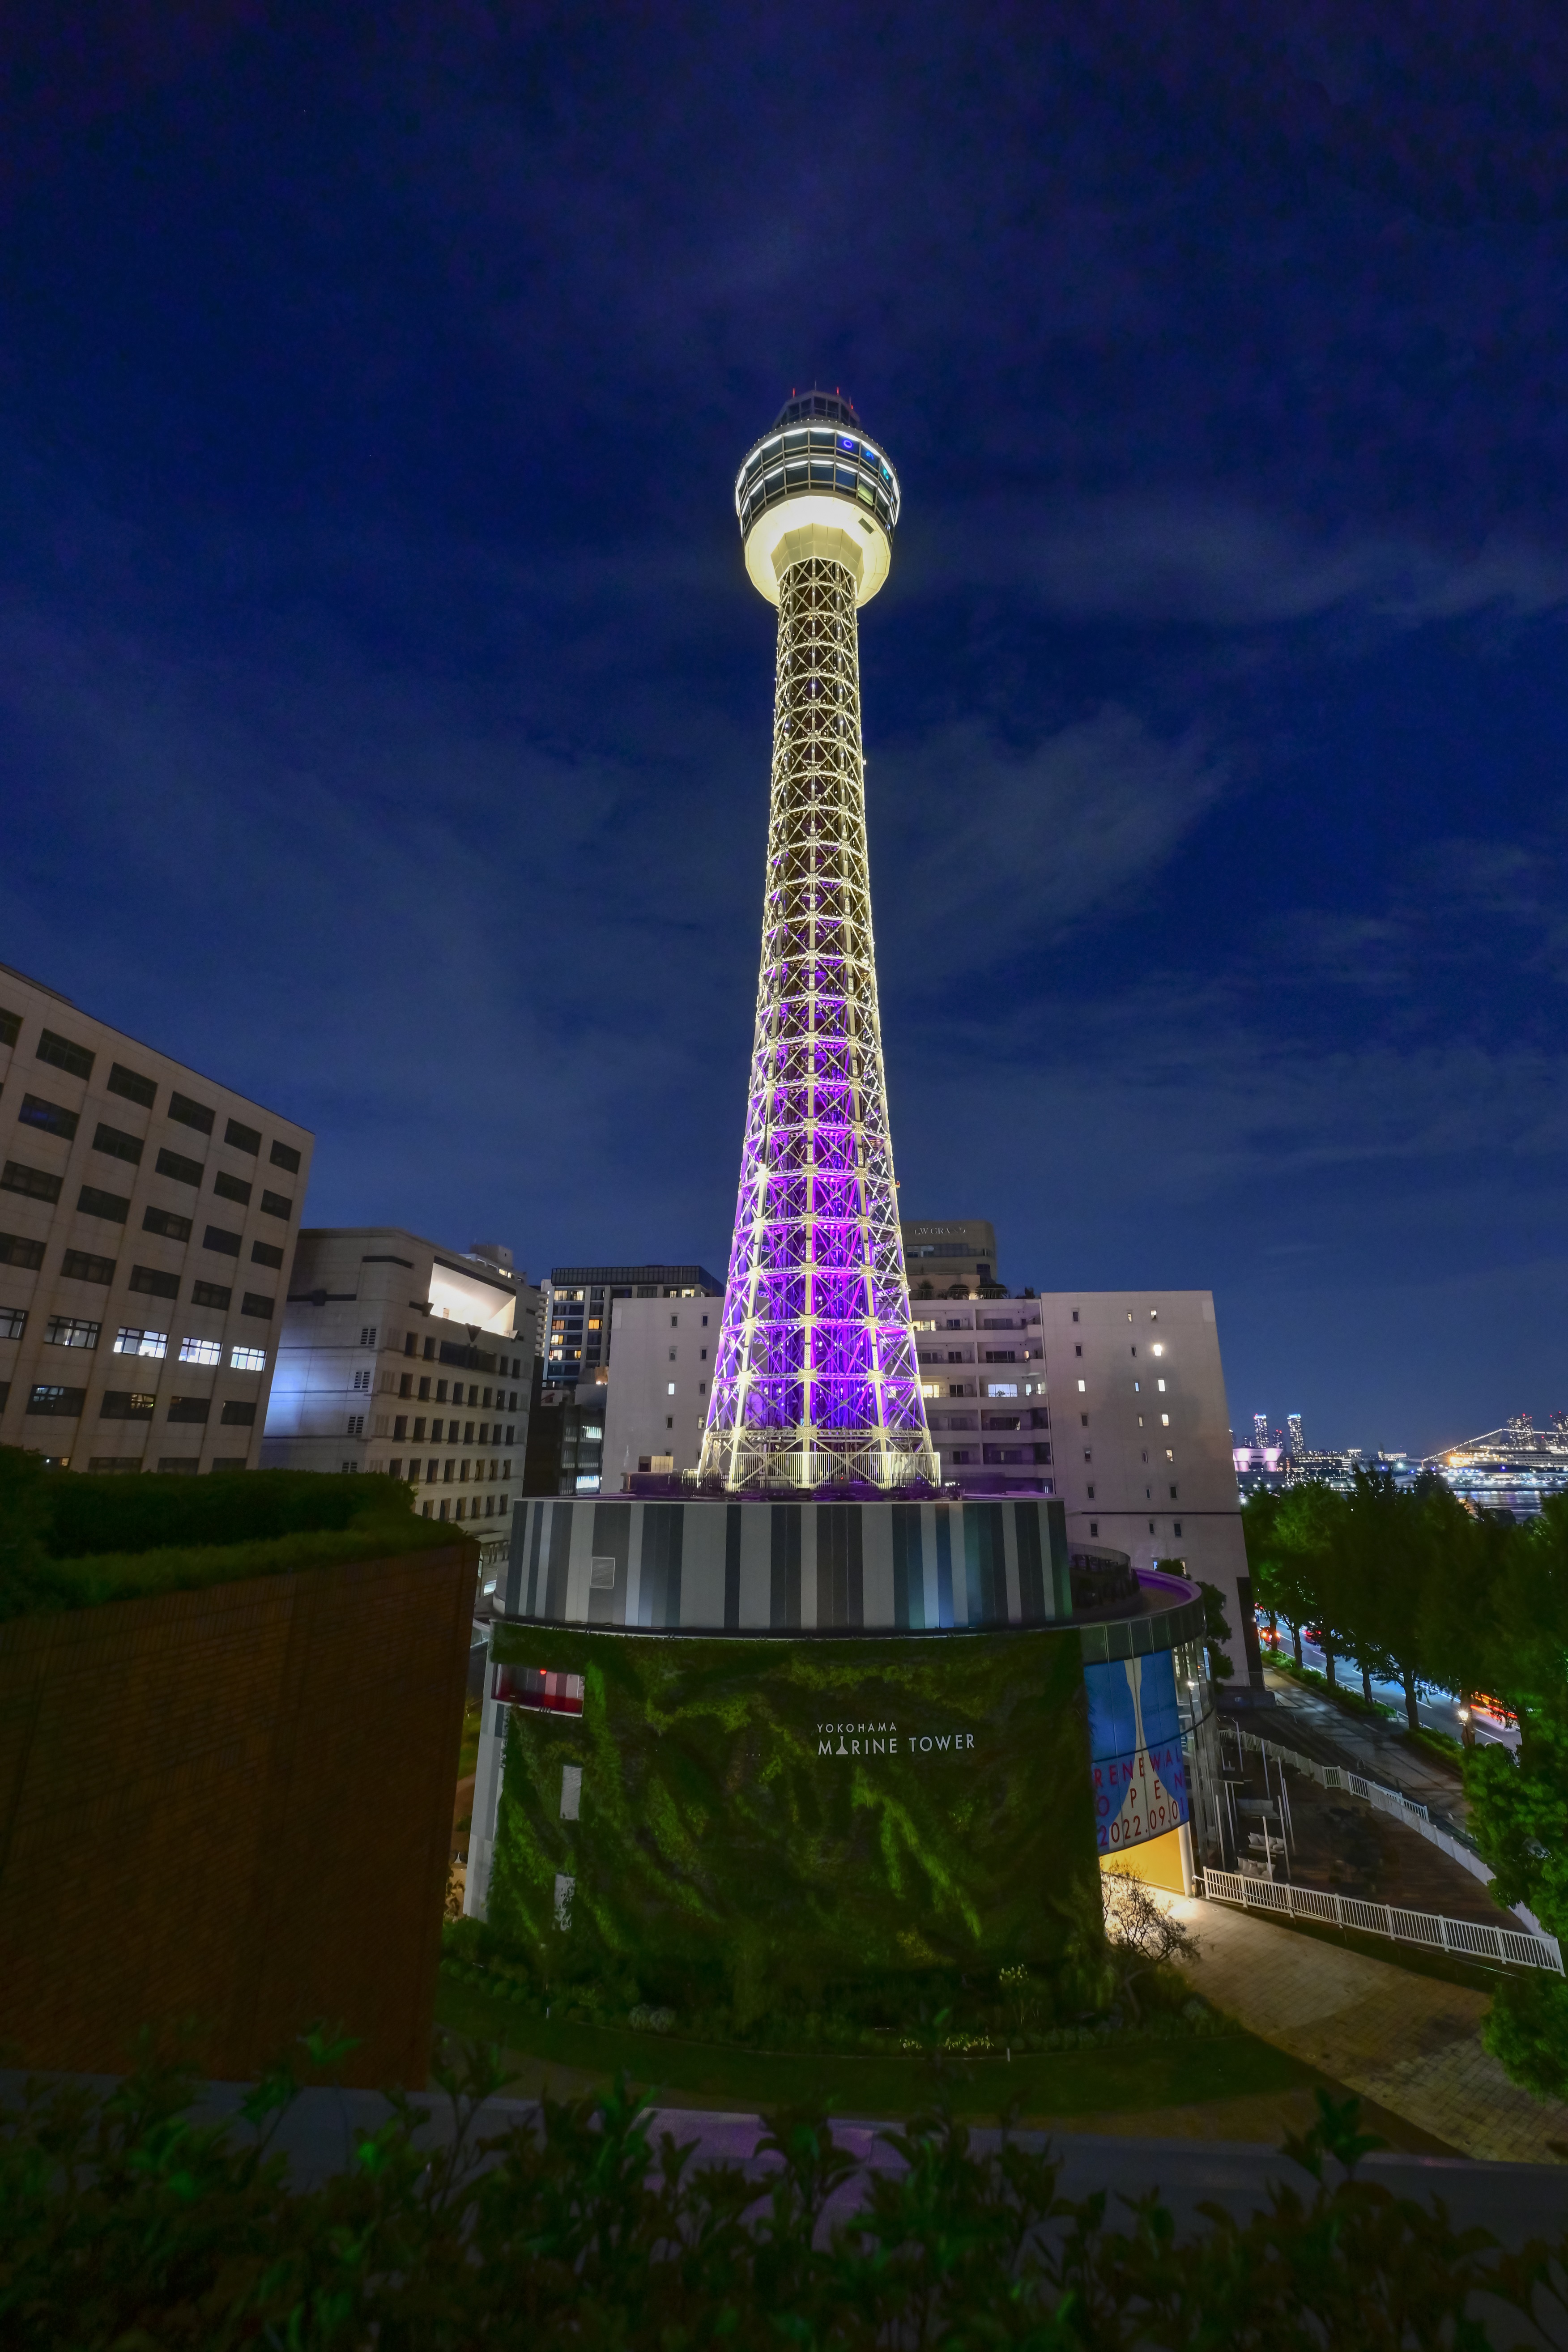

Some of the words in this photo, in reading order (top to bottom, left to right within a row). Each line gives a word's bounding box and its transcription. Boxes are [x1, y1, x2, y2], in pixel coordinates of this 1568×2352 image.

[817, 1722, 897, 1733] YOKOHAMA
[908, 1734, 975, 1752] TOWER
[1094, 1746, 1181, 1787] RENEWAL
[1099, 1797, 1185, 1847] 2022.09.01
